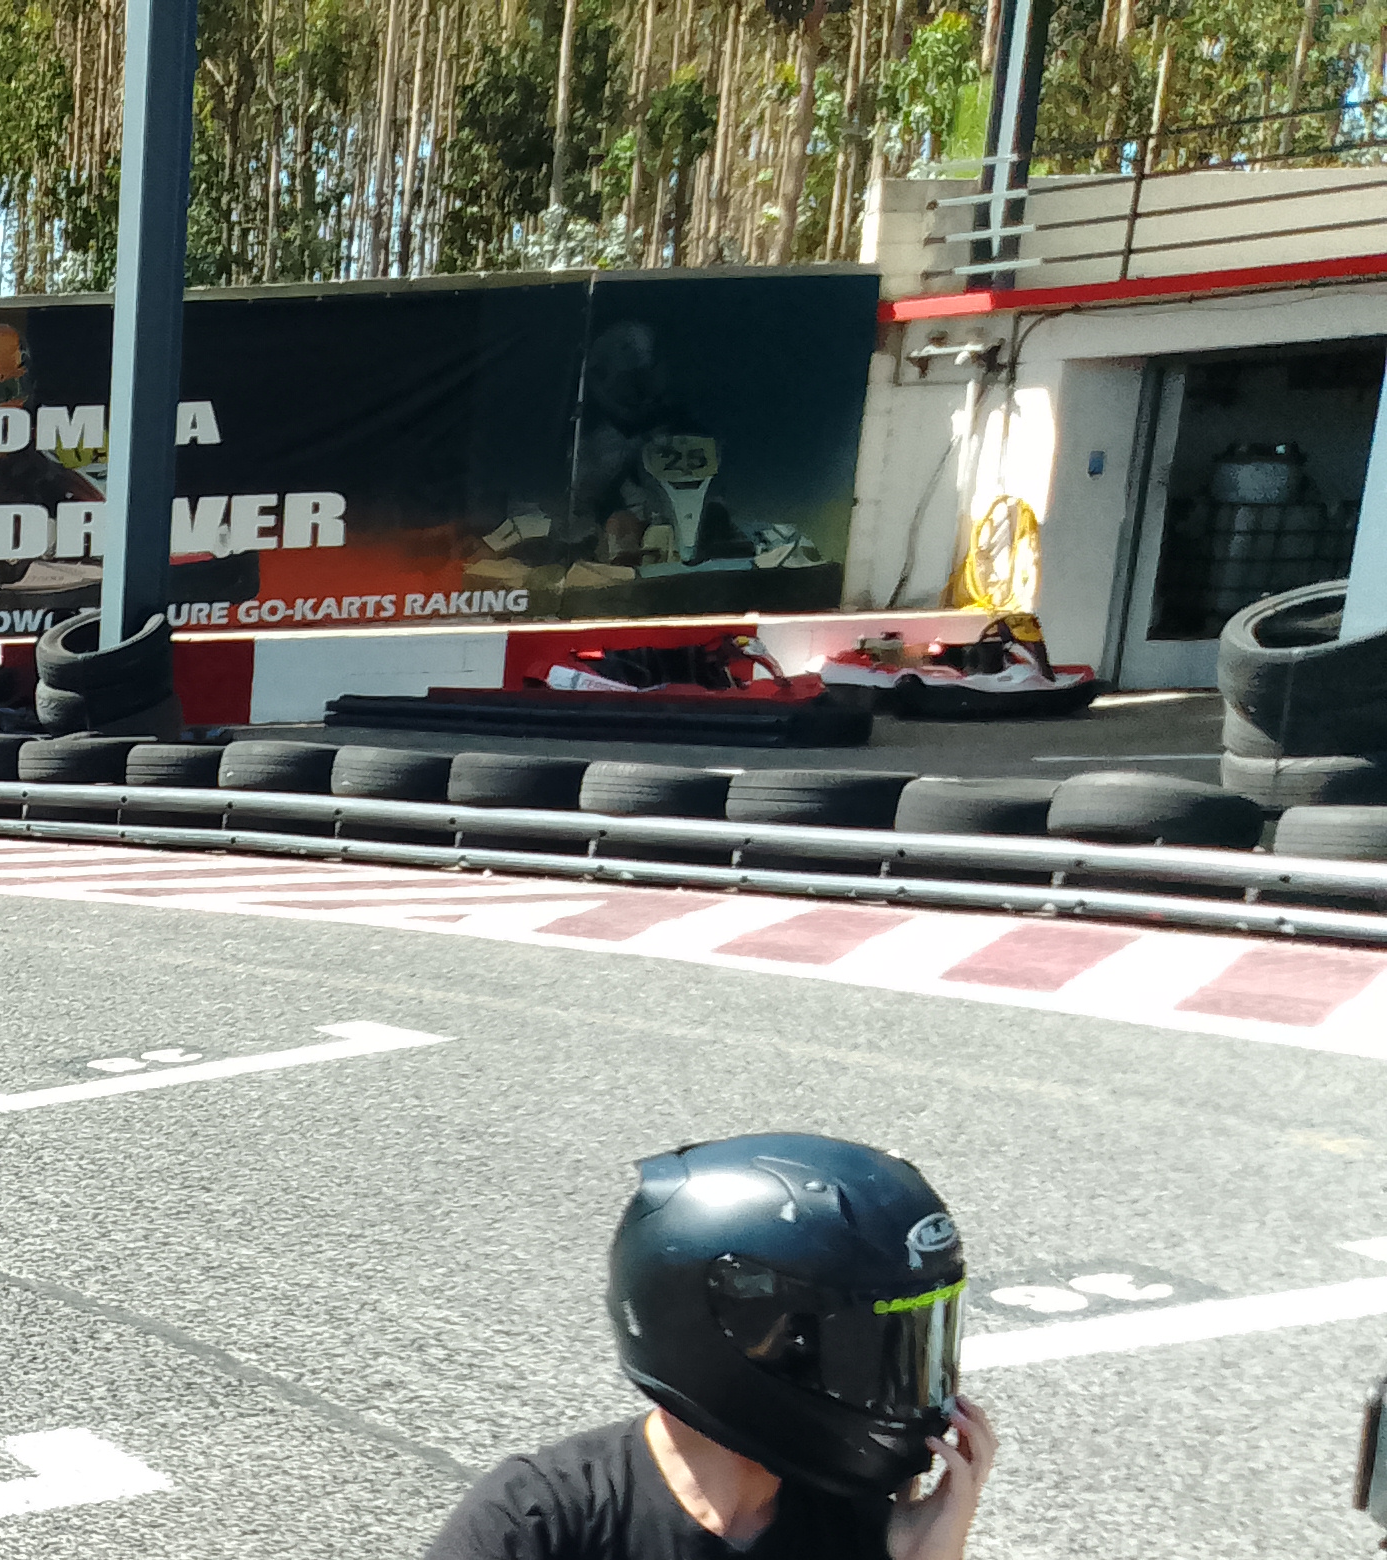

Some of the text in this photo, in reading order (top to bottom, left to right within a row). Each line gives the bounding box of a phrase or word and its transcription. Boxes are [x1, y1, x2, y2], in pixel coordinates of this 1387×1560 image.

[175, 401, 222, 446] A
[236, 593, 397, 623] GO-KARTS
[404, 589, 529, 617] RAKING
